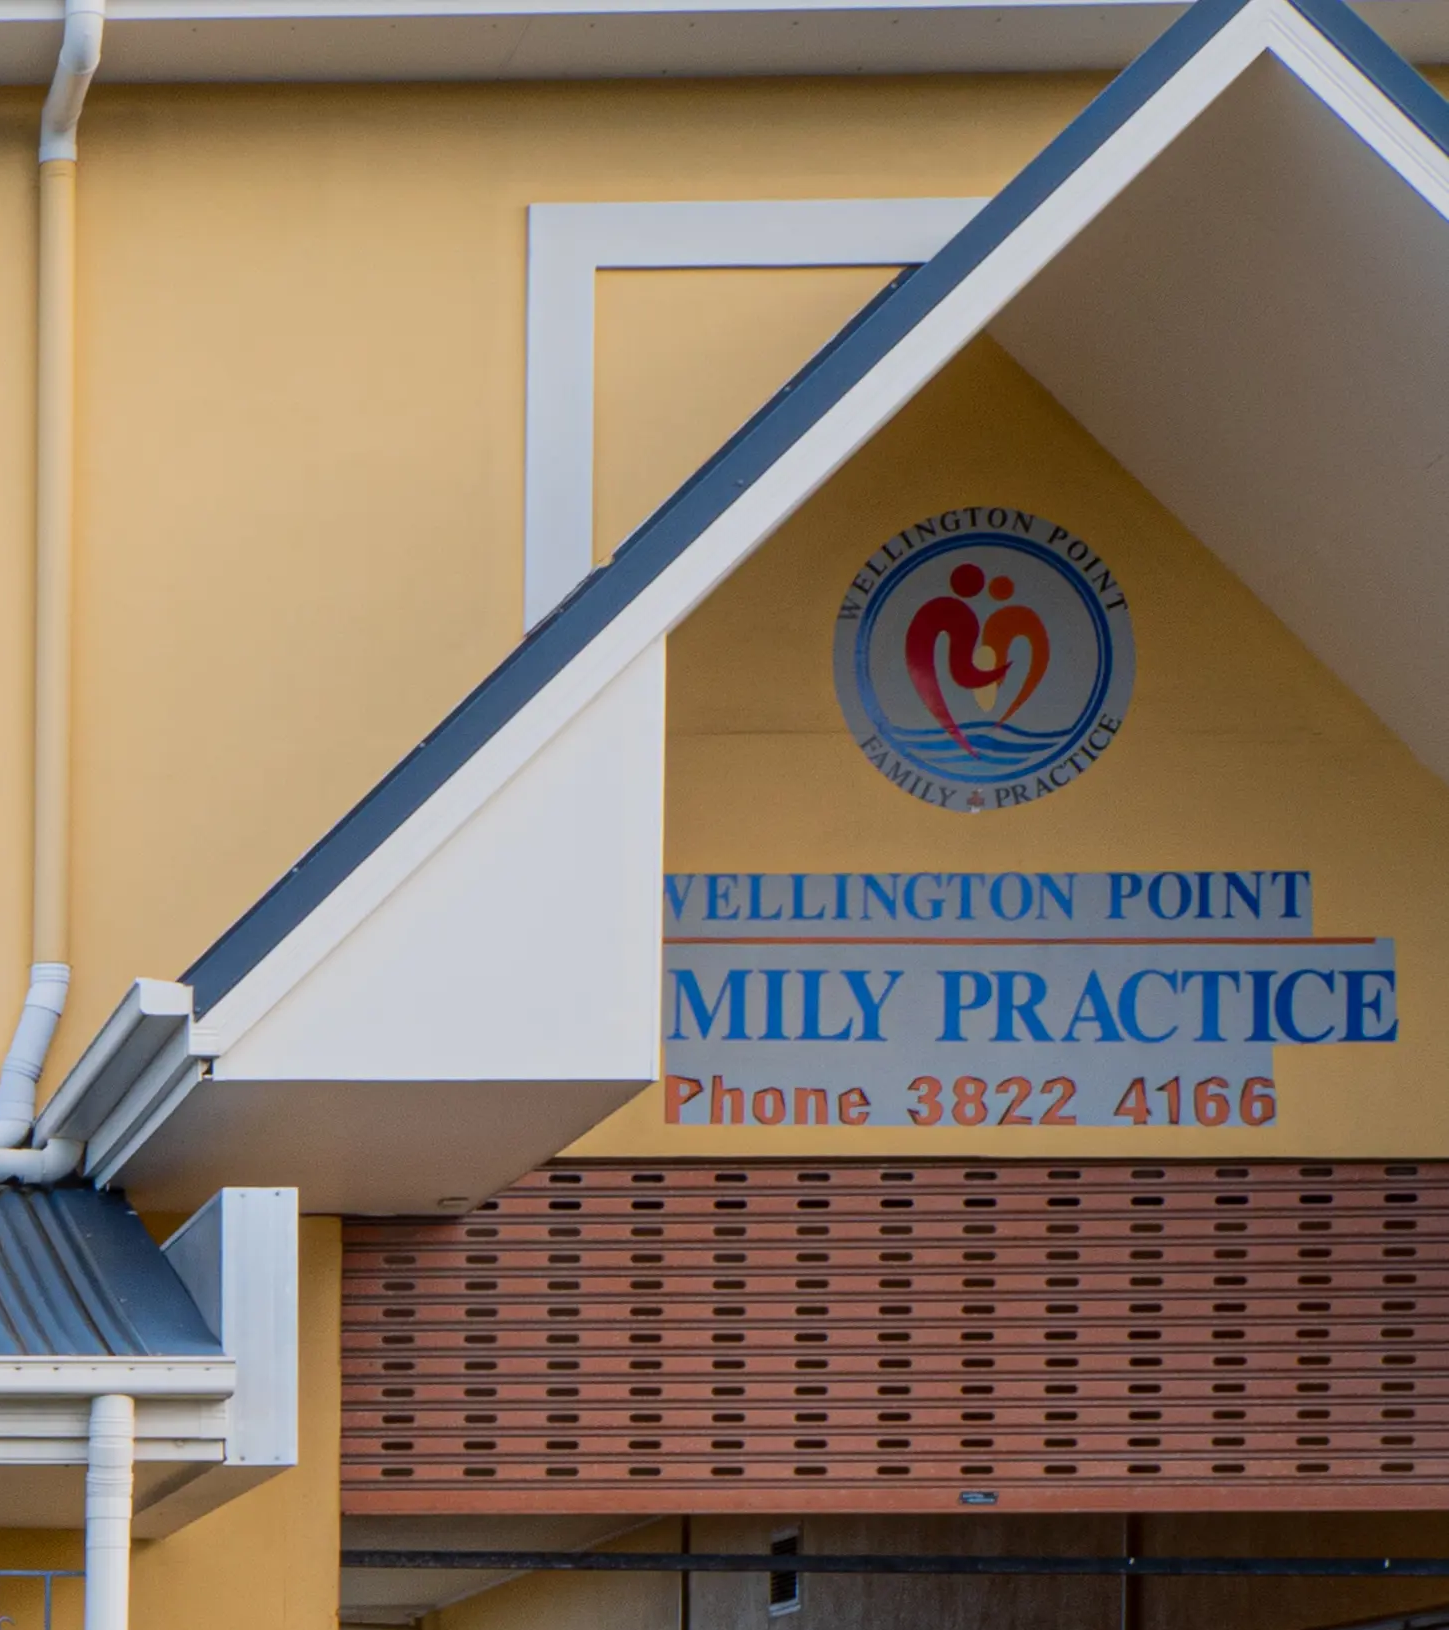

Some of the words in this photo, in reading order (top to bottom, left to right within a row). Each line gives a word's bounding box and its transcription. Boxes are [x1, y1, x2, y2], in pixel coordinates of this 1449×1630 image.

[838, 507, 1034, 624] WELLINGTON
[1048, 525, 1129, 615] POINT
[858, 732, 958, 809] FAMILY
[995, 713, 1122, 809] PRACTICE
[1107, 871, 1313, 922] POINT
[666, 969, 905, 1042] MILY
[935, 969, 1400, 1043] PRACTICE
[664, 1074, 871, 1126] Phone
[907, 1076, 1078, 1126] 3822
[1114, 1075, 1277, 1126] 4166
